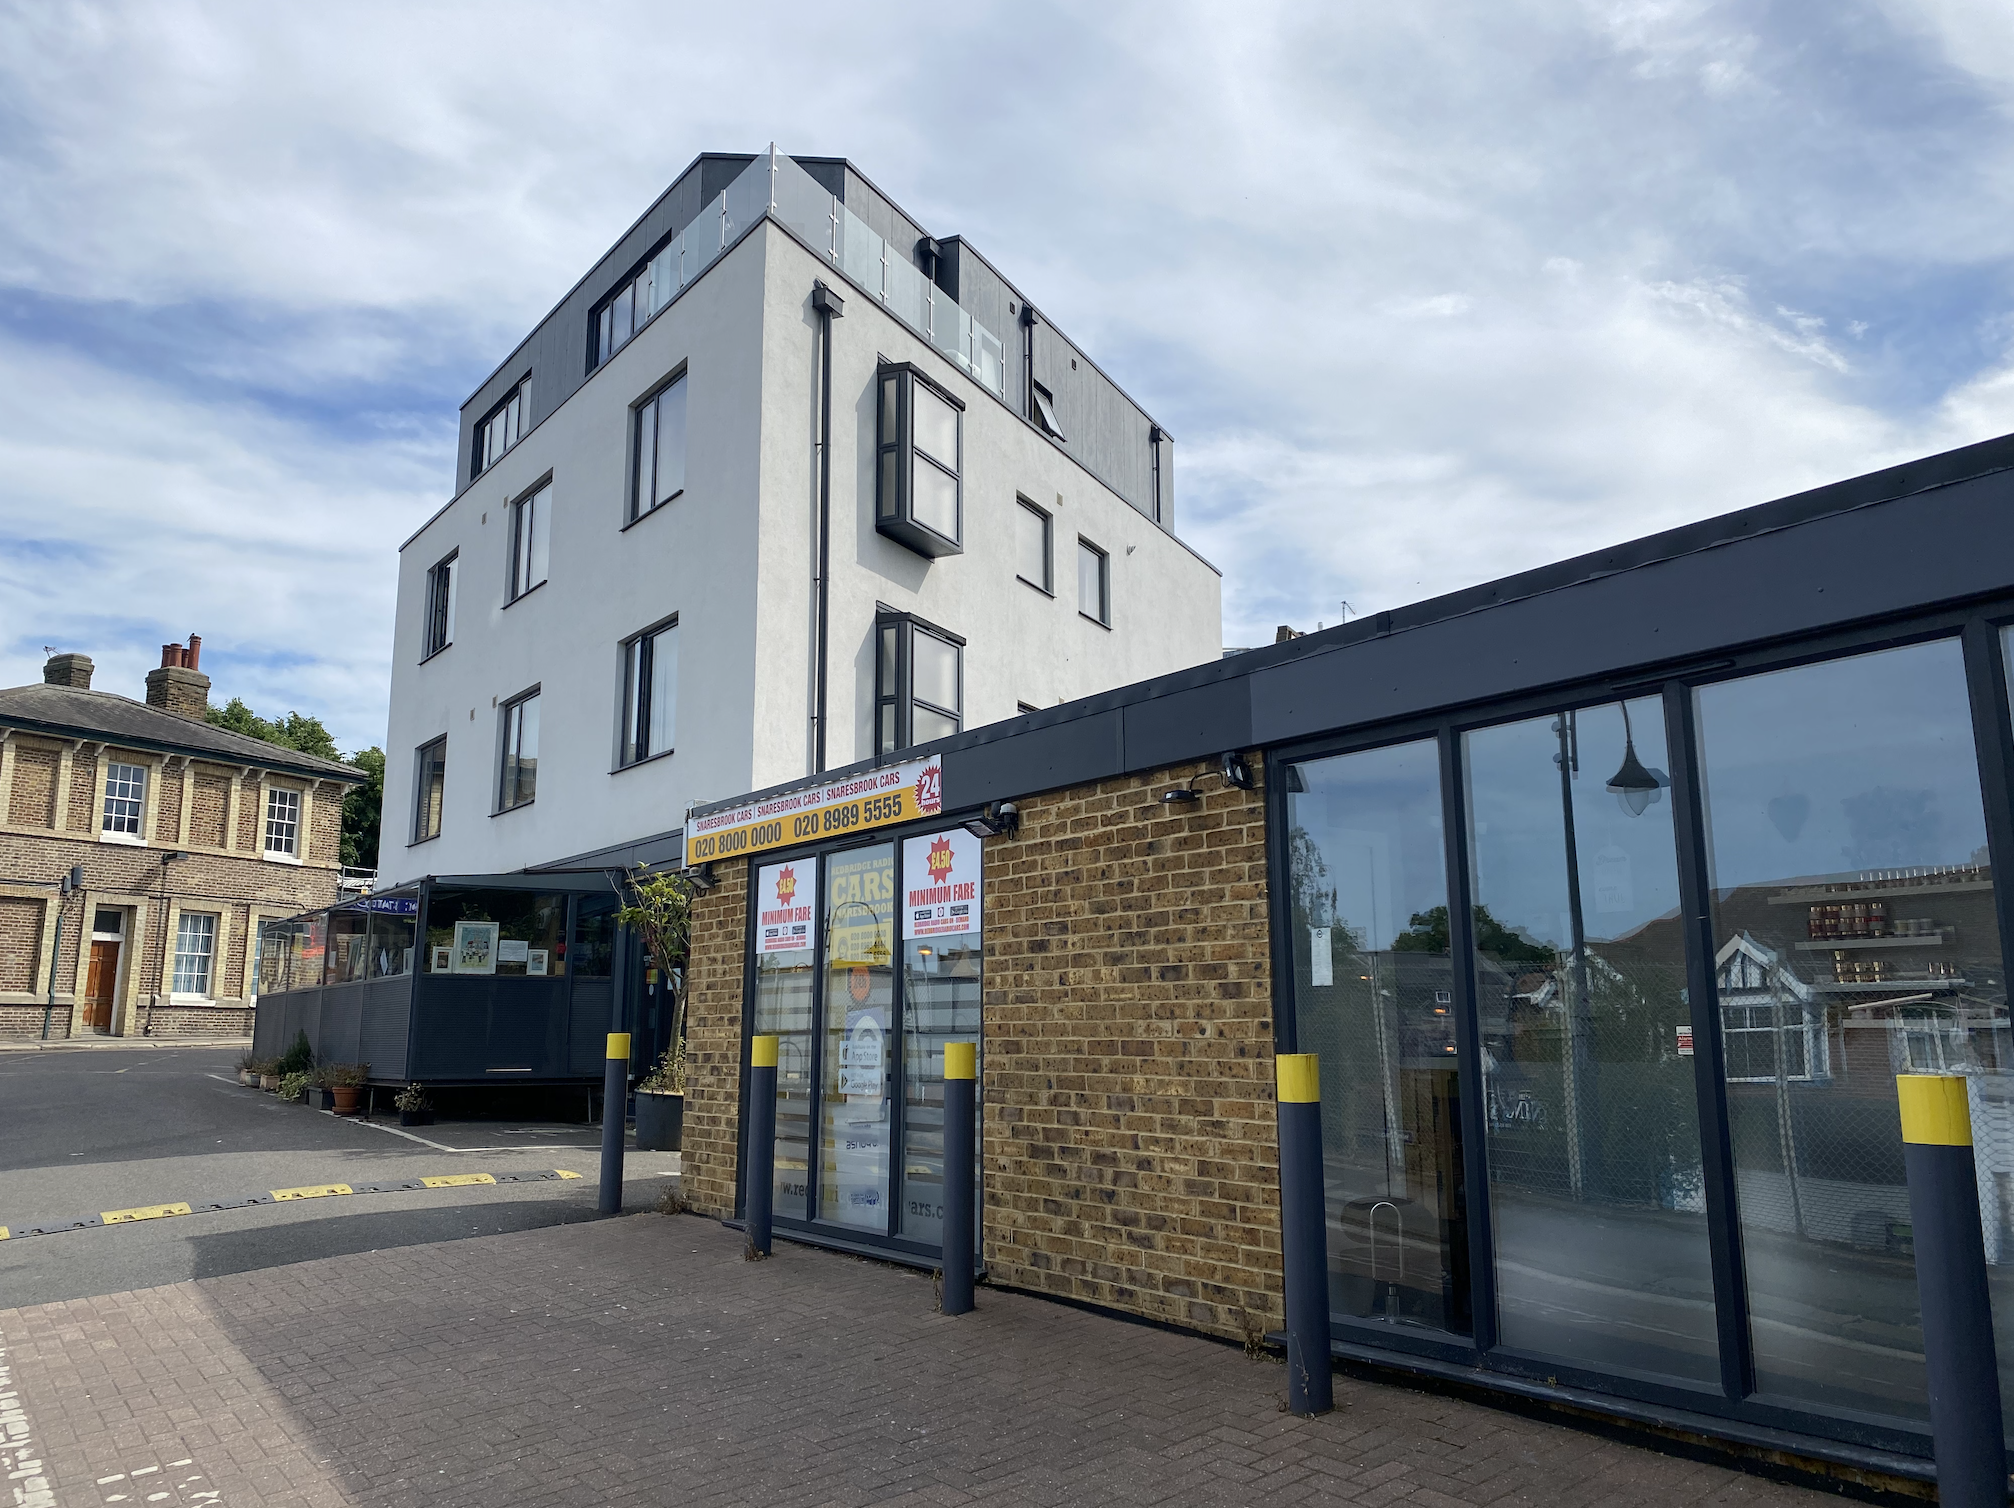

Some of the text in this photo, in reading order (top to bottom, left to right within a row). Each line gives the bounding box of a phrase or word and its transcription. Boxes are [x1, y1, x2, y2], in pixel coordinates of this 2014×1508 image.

[921, 773, 940, 799] 24
[696, 771, 900, 832] SNARESBROOK CARS SNARESBROOK CARS SNARESBROOK CARS
[921, 797, 940, 806] hours
[695, 794, 902, 858] 020 8000 0000 020 8989 5555
[831, 861, 871, 875] REDBRIDGE
[931, 849, 950, 870] £4.50
[832, 868, 893, 907] CARS
[909, 881, 975, 907] MINIMUM FARE
[761, 905, 811, 926] MINIMUM FARE
[852, 1051, 878, 1063] App Store
[850, 1080, 867, 1091] Google
